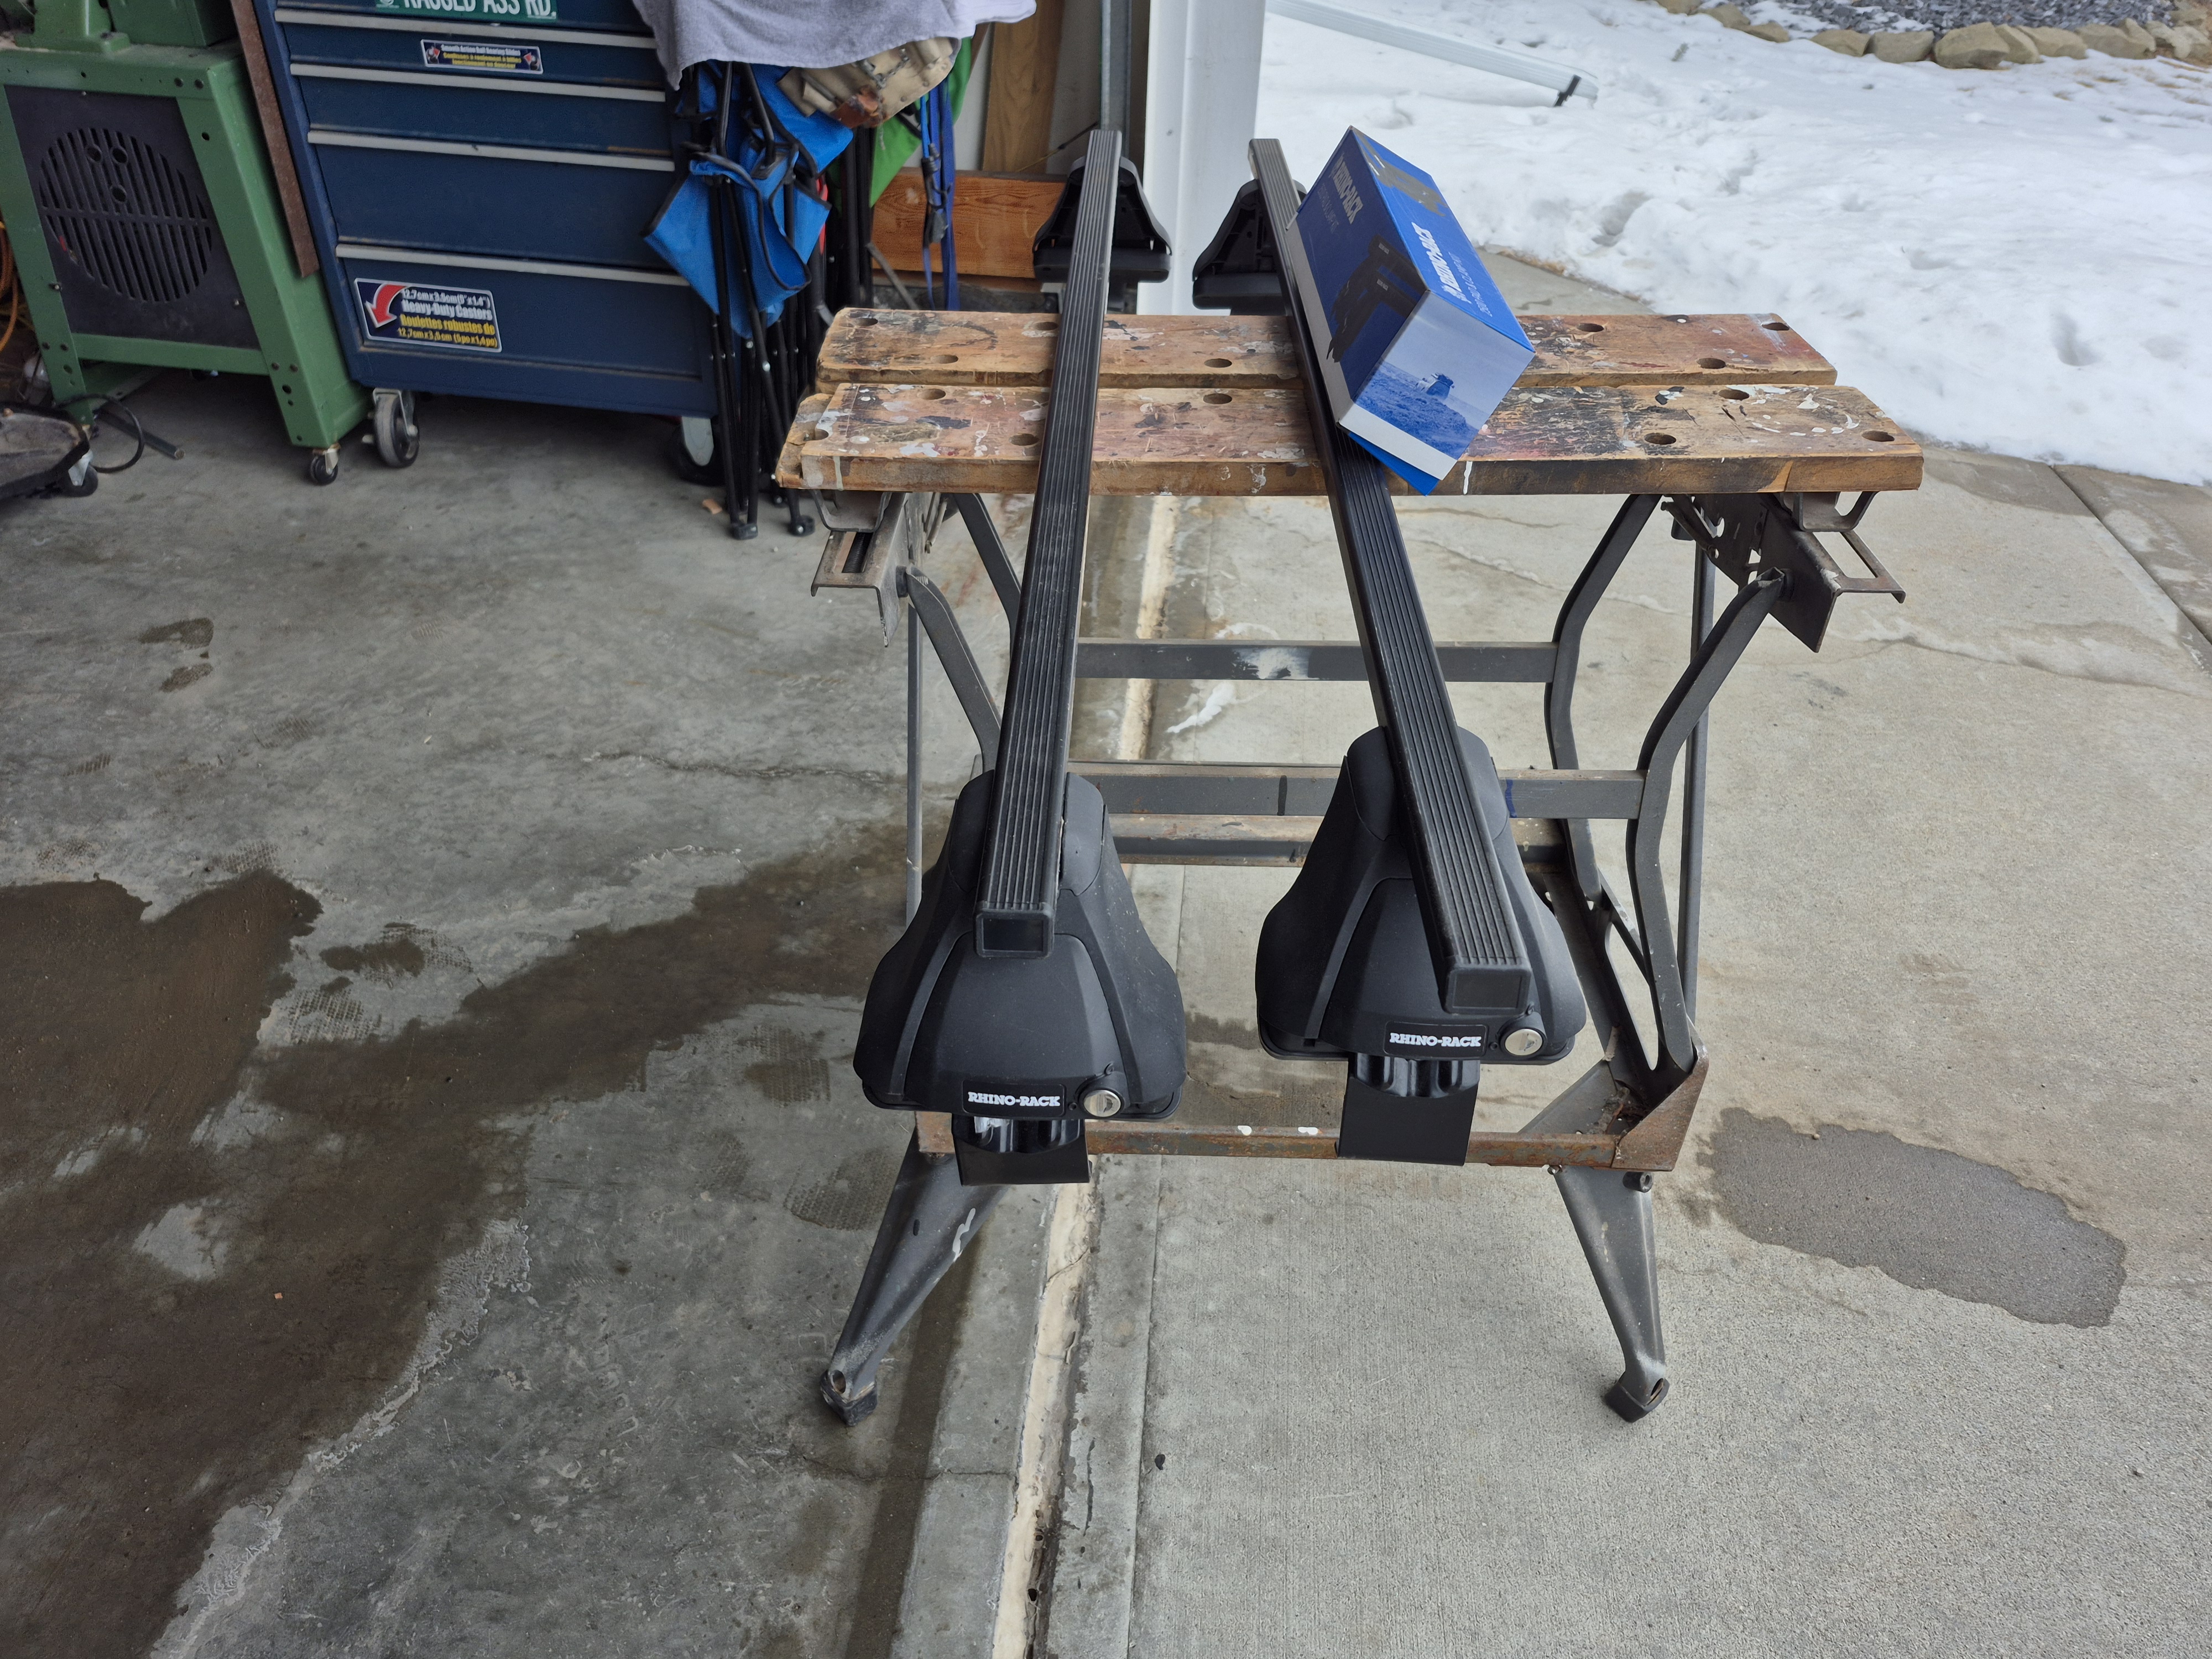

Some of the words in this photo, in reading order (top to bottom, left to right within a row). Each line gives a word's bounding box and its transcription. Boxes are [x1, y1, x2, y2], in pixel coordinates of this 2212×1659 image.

[1333, 161, 1363, 225] RHINO-RACK
[401, 299, 455, 317] Heavy-Duty
[455, 305, 493, 321] Casters
[400, 314, 442, 330] Roulettes
[443, 319, 483, 334] robustes
[483, 322, 495, 336] de
[1389, 1032, 1481, 1047] RHINO-RACK
[968, 1092, 1060, 1107] RHINO-RACK
